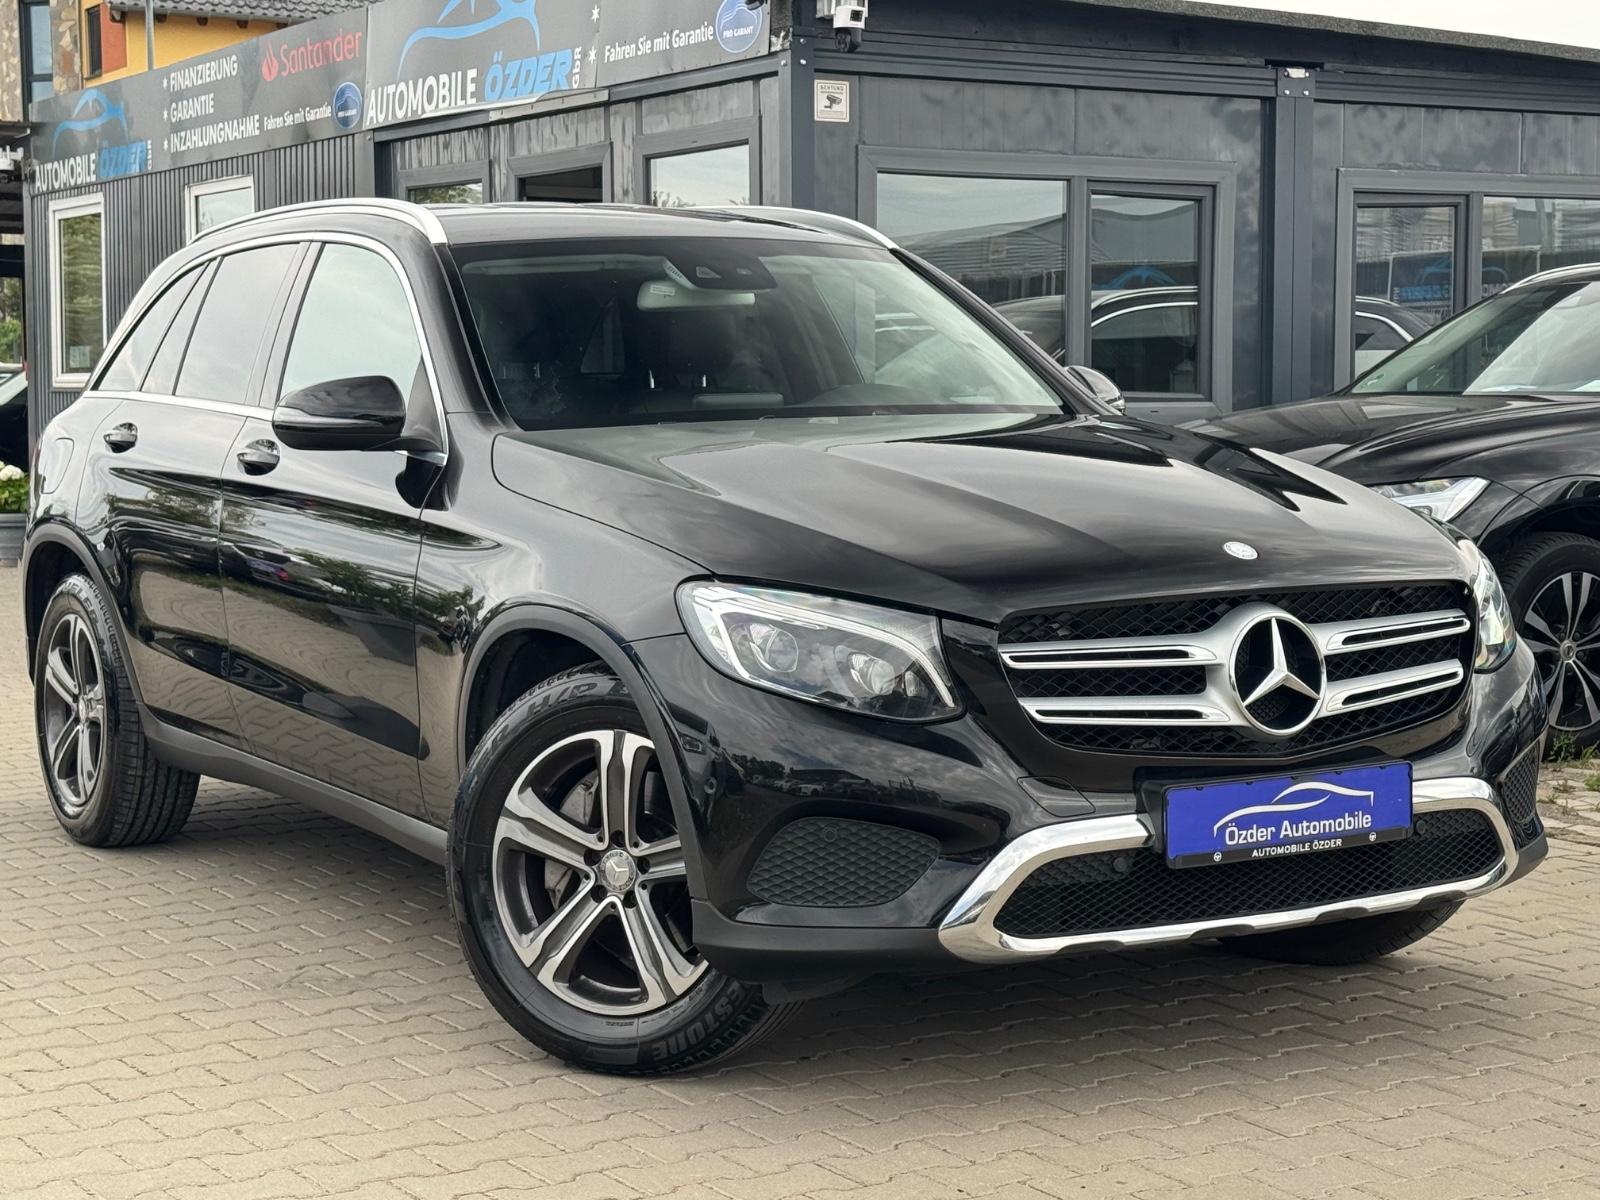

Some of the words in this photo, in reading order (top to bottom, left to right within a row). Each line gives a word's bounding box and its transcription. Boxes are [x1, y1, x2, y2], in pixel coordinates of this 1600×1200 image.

[280, 28, 362, 77] Santander
[604, 42, 636, 63] Fahren
[637, 35, 652, 56] Sie
[653, 30, 671, 52] mit
[671, 21, 714, 48] Garantie
[170, 55, 238, 92] FINANZIERUNG
[366, 68, 478, 126] AUTOMOBILE
[484, 49, 573, 103] ÖZDER
[572, 46, 582, 89] GbR
[170, 93, 214, 122] GARANTIE
[264, 115, 284, 131] Fahren
[284, 111, 294, 126] Sie
[294, 108, 305, 124] mit
[305, 101, 332, 122] Garantie
[170, 114, 260, 153] INZAHLUNGNAHME
[35, 153, 97, 192] AUTOMOBILE
[1225, 823, 1276, 846] Özder
[1279, 811, 1372, 839] Automobile
[1251, 842, 1311, 858] AUTOMOBILE
[1312, 839, 1342, 850] ÖZDER
